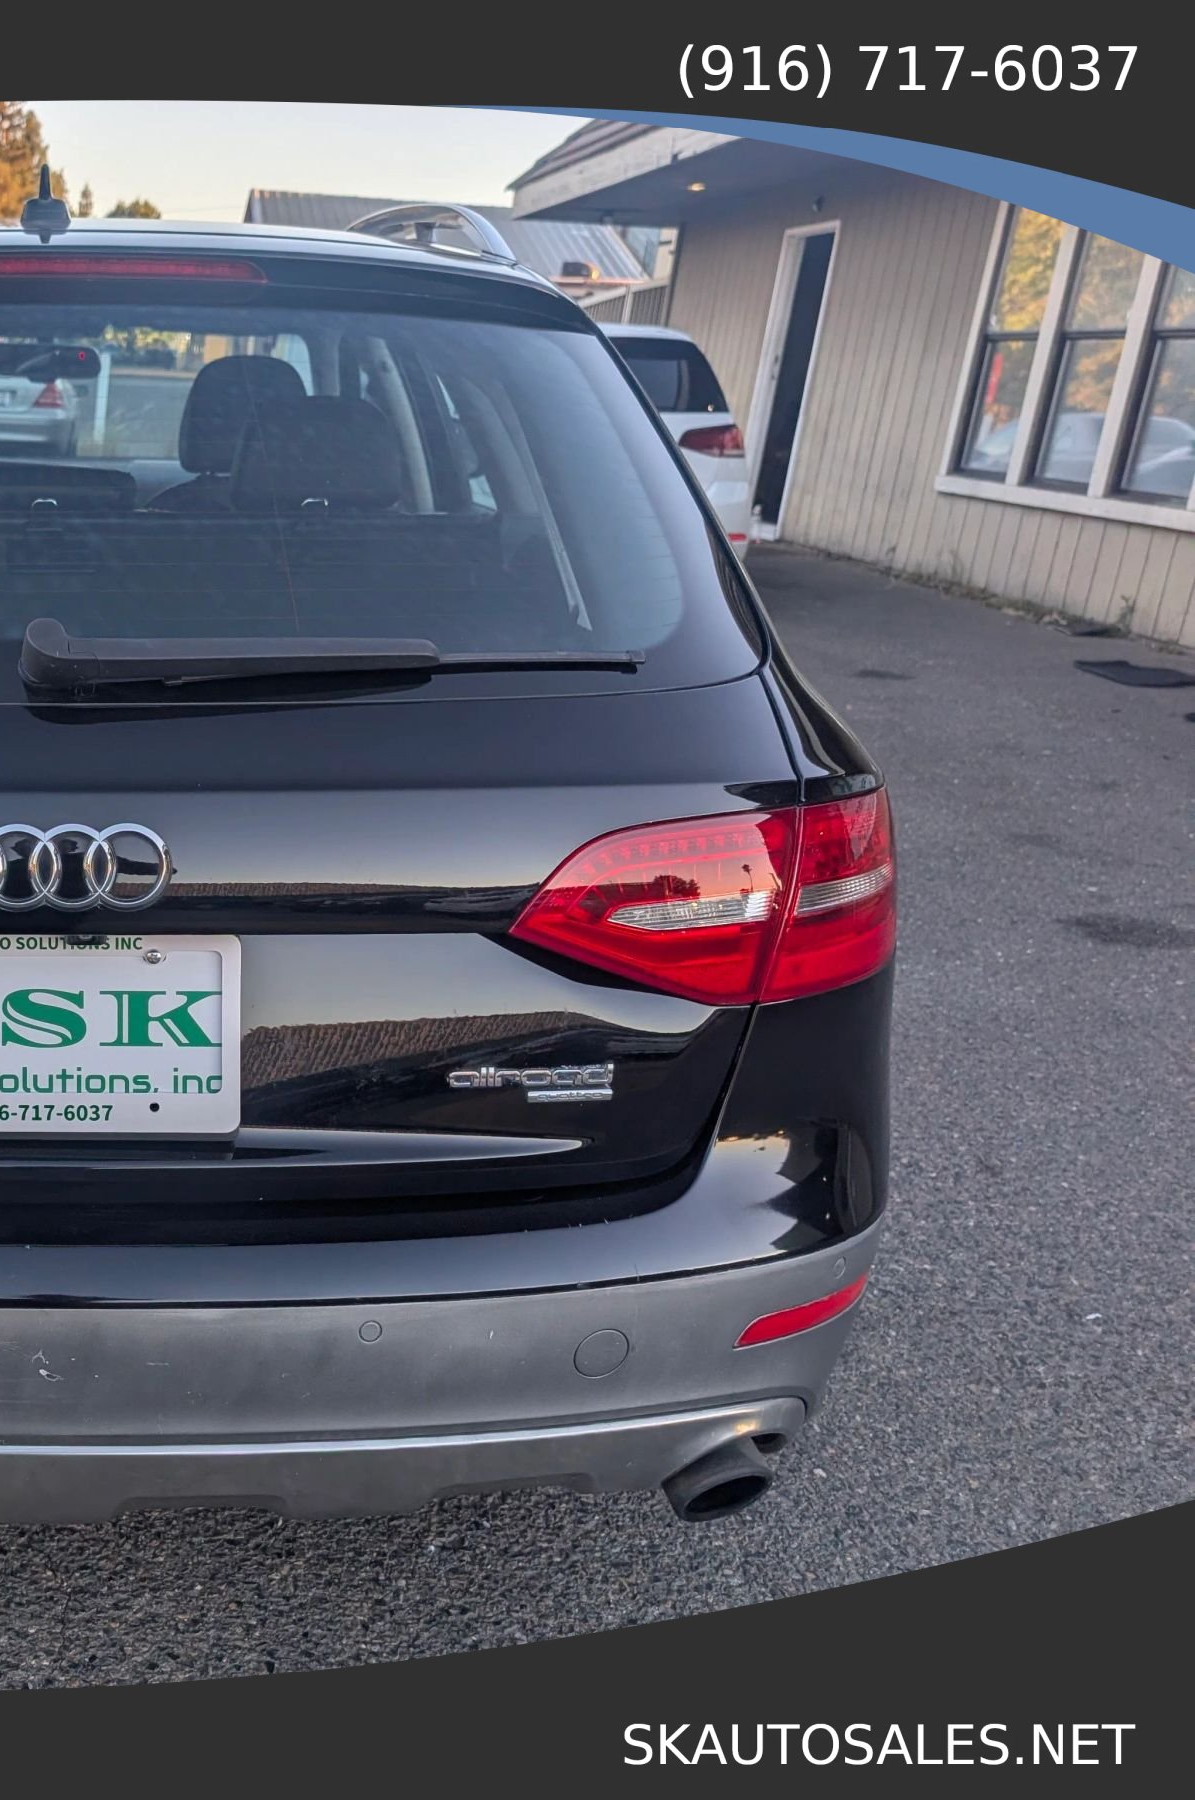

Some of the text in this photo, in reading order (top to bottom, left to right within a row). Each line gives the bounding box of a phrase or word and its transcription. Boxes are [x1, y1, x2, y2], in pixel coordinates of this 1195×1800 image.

[115, 936, 143, 950] INC
[1, 988, 222, 1048] SK
[173, 1067, 223, 1094] inc
[447, 1063, 614, 1088] allroad
